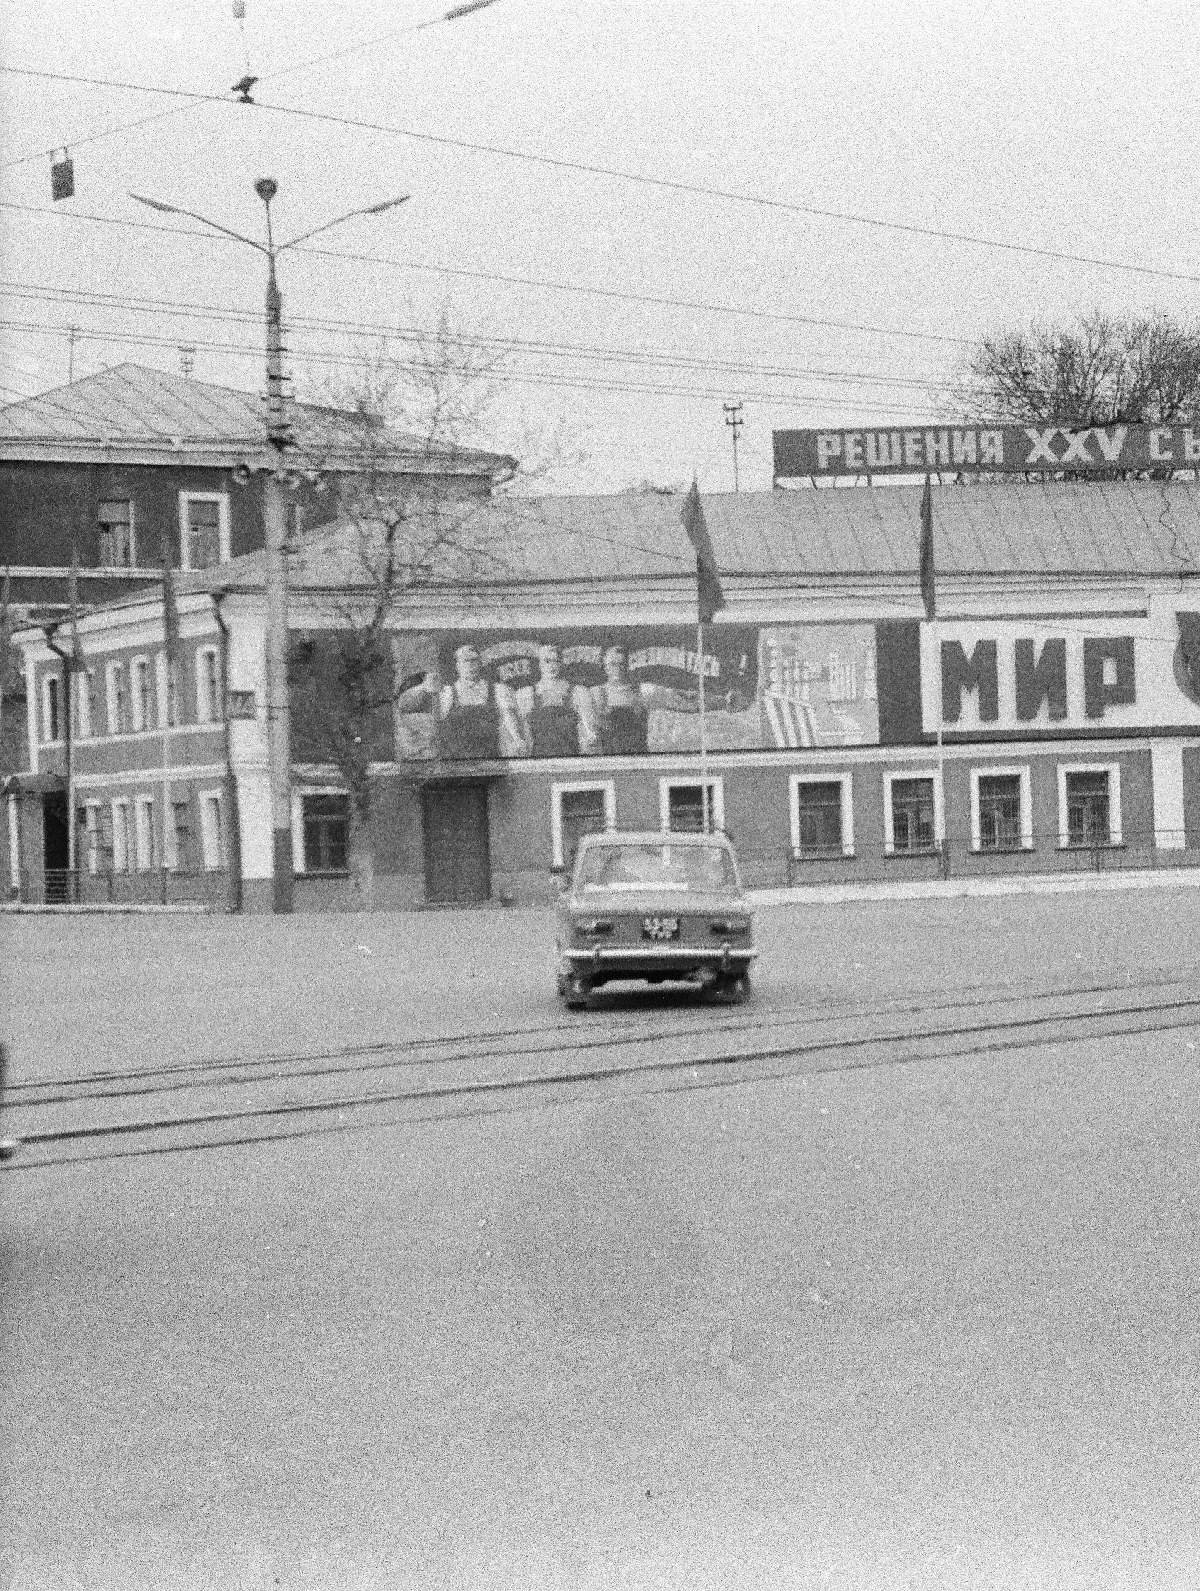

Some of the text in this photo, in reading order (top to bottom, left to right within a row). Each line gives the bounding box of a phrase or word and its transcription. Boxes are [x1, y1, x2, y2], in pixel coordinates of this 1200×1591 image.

[816, 431, 1004, 468] РЕШЕНИЯ
[1025, 427, 1126, 463] XXV
[941, 636, 1136, 722] МИР
